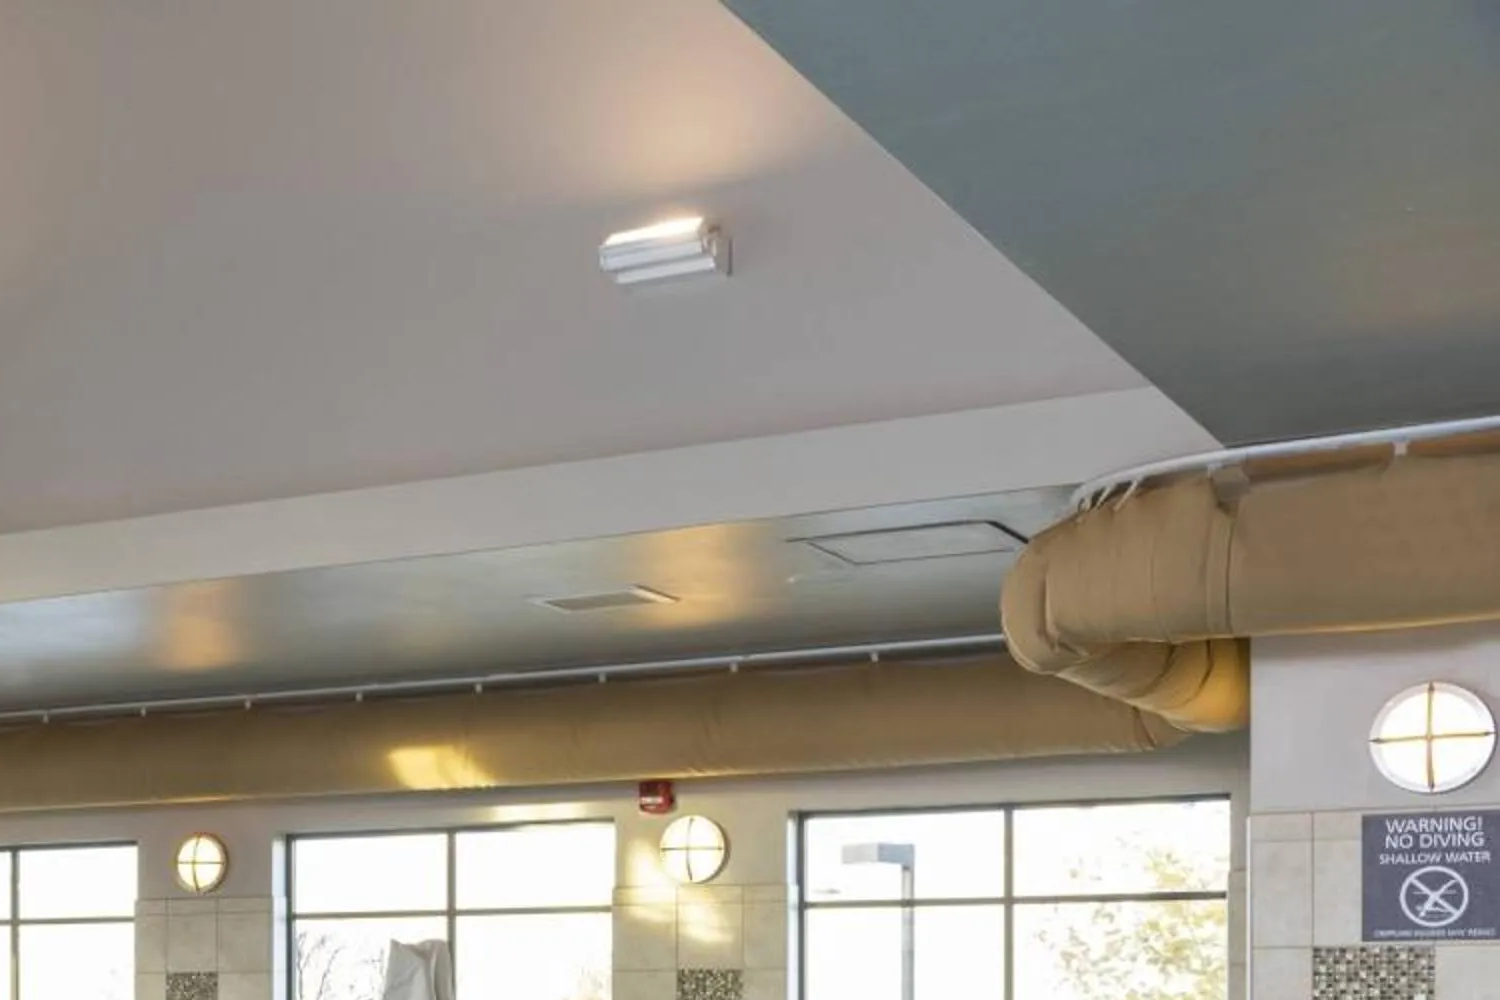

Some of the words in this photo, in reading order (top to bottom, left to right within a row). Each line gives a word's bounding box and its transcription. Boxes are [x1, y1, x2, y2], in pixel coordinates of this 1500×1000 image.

[1385, 816, 1483, 834] WARNING!
[1385, 834, 1414, 849] NO
[1420, 832, 1485, 849] DIVING
[1379, 852, 1442, 865] SHALLOW
[1445, 850, 1491, 863] WATER
